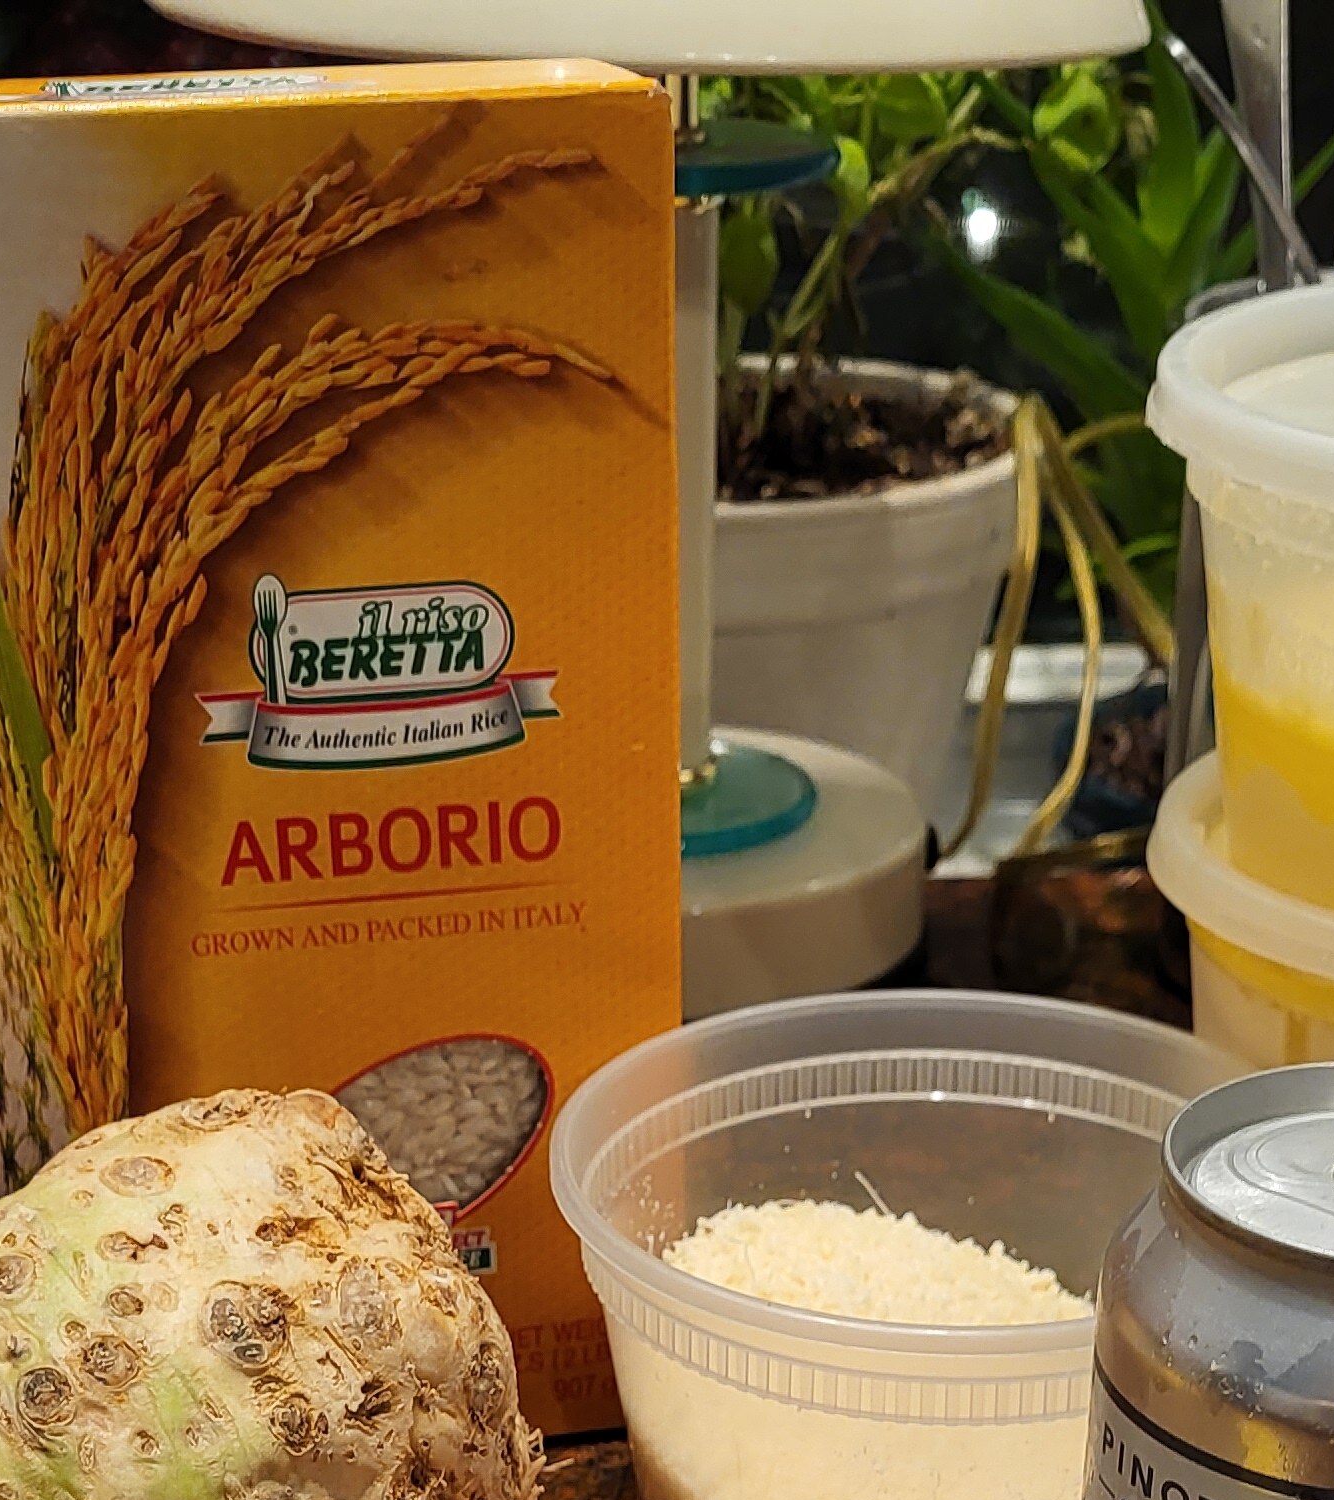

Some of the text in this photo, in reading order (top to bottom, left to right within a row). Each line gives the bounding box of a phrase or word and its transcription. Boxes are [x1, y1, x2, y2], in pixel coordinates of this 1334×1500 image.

[289, 631, 485, 687] BERETTA
[264, 708, 509, 750] The Authentic Italian Rice
[221, 796, 562, 887] ARBORIO
[191, 902, 586, 958] GROWN AND PACKED IN ITALY
